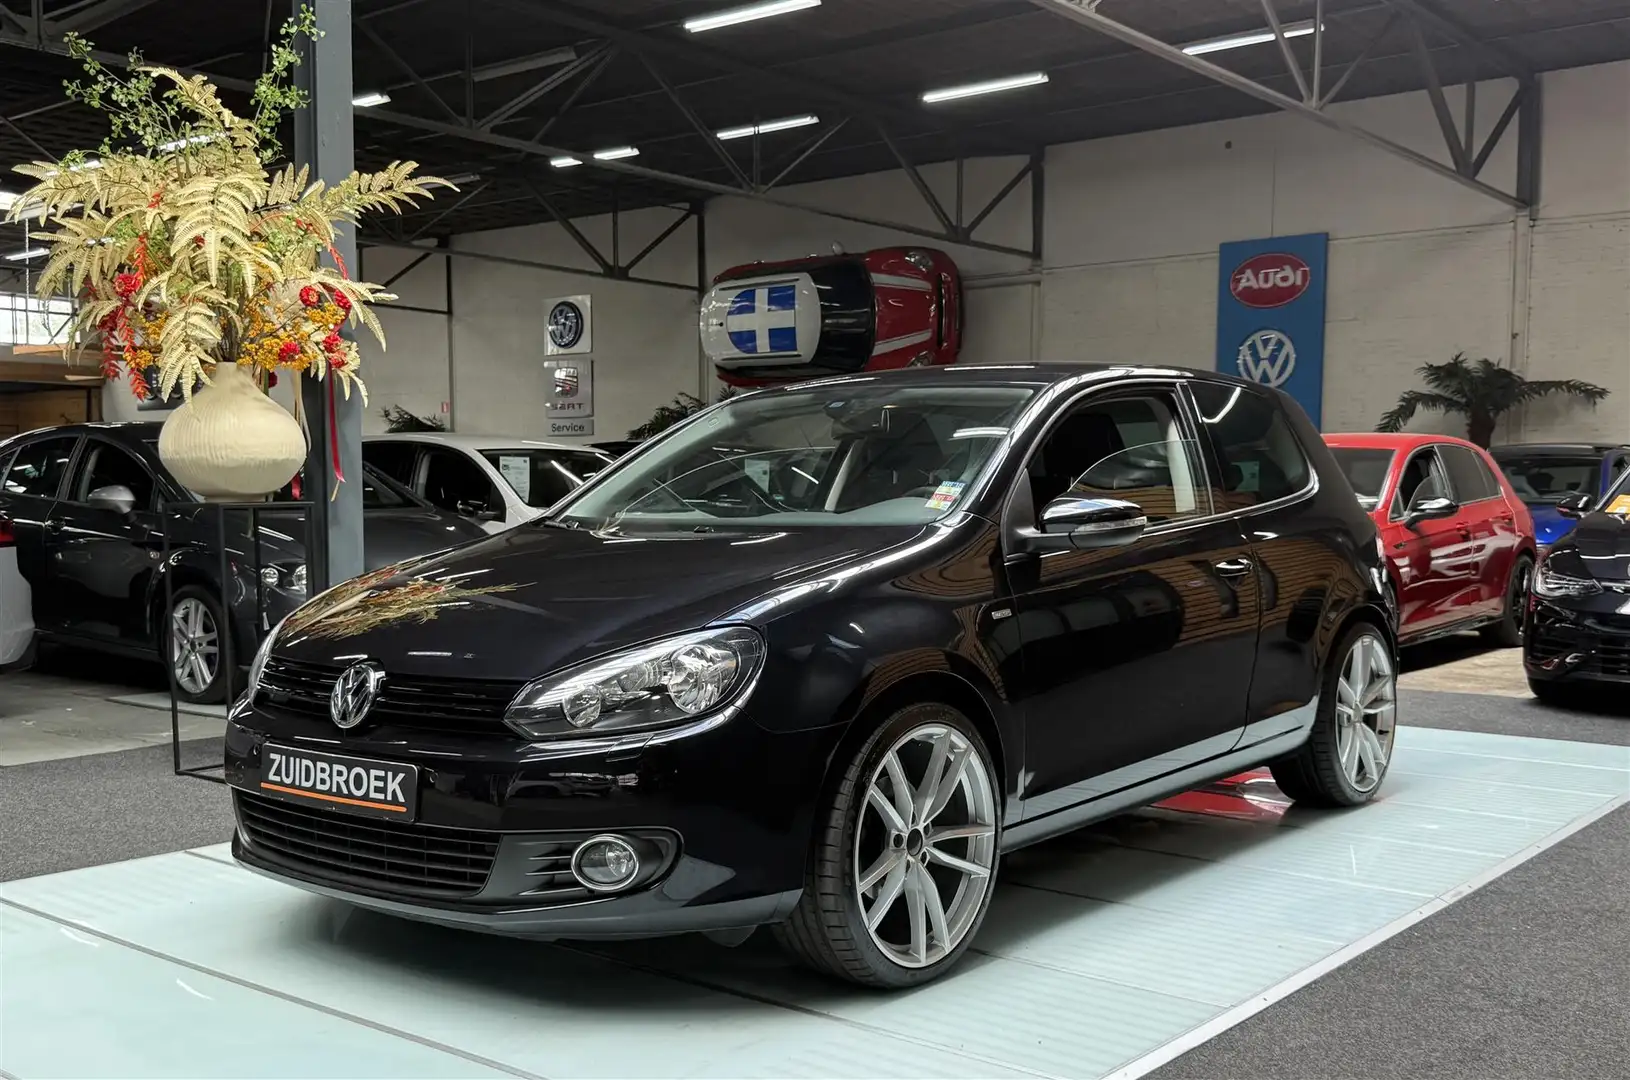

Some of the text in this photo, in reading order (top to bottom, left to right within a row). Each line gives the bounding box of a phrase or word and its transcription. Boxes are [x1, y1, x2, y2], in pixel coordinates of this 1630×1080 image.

[1239, 330, 1295, 387] VW
[551, 423, 585, 432] Service
[268, 753, 406, 803] ZUIDBROEK
